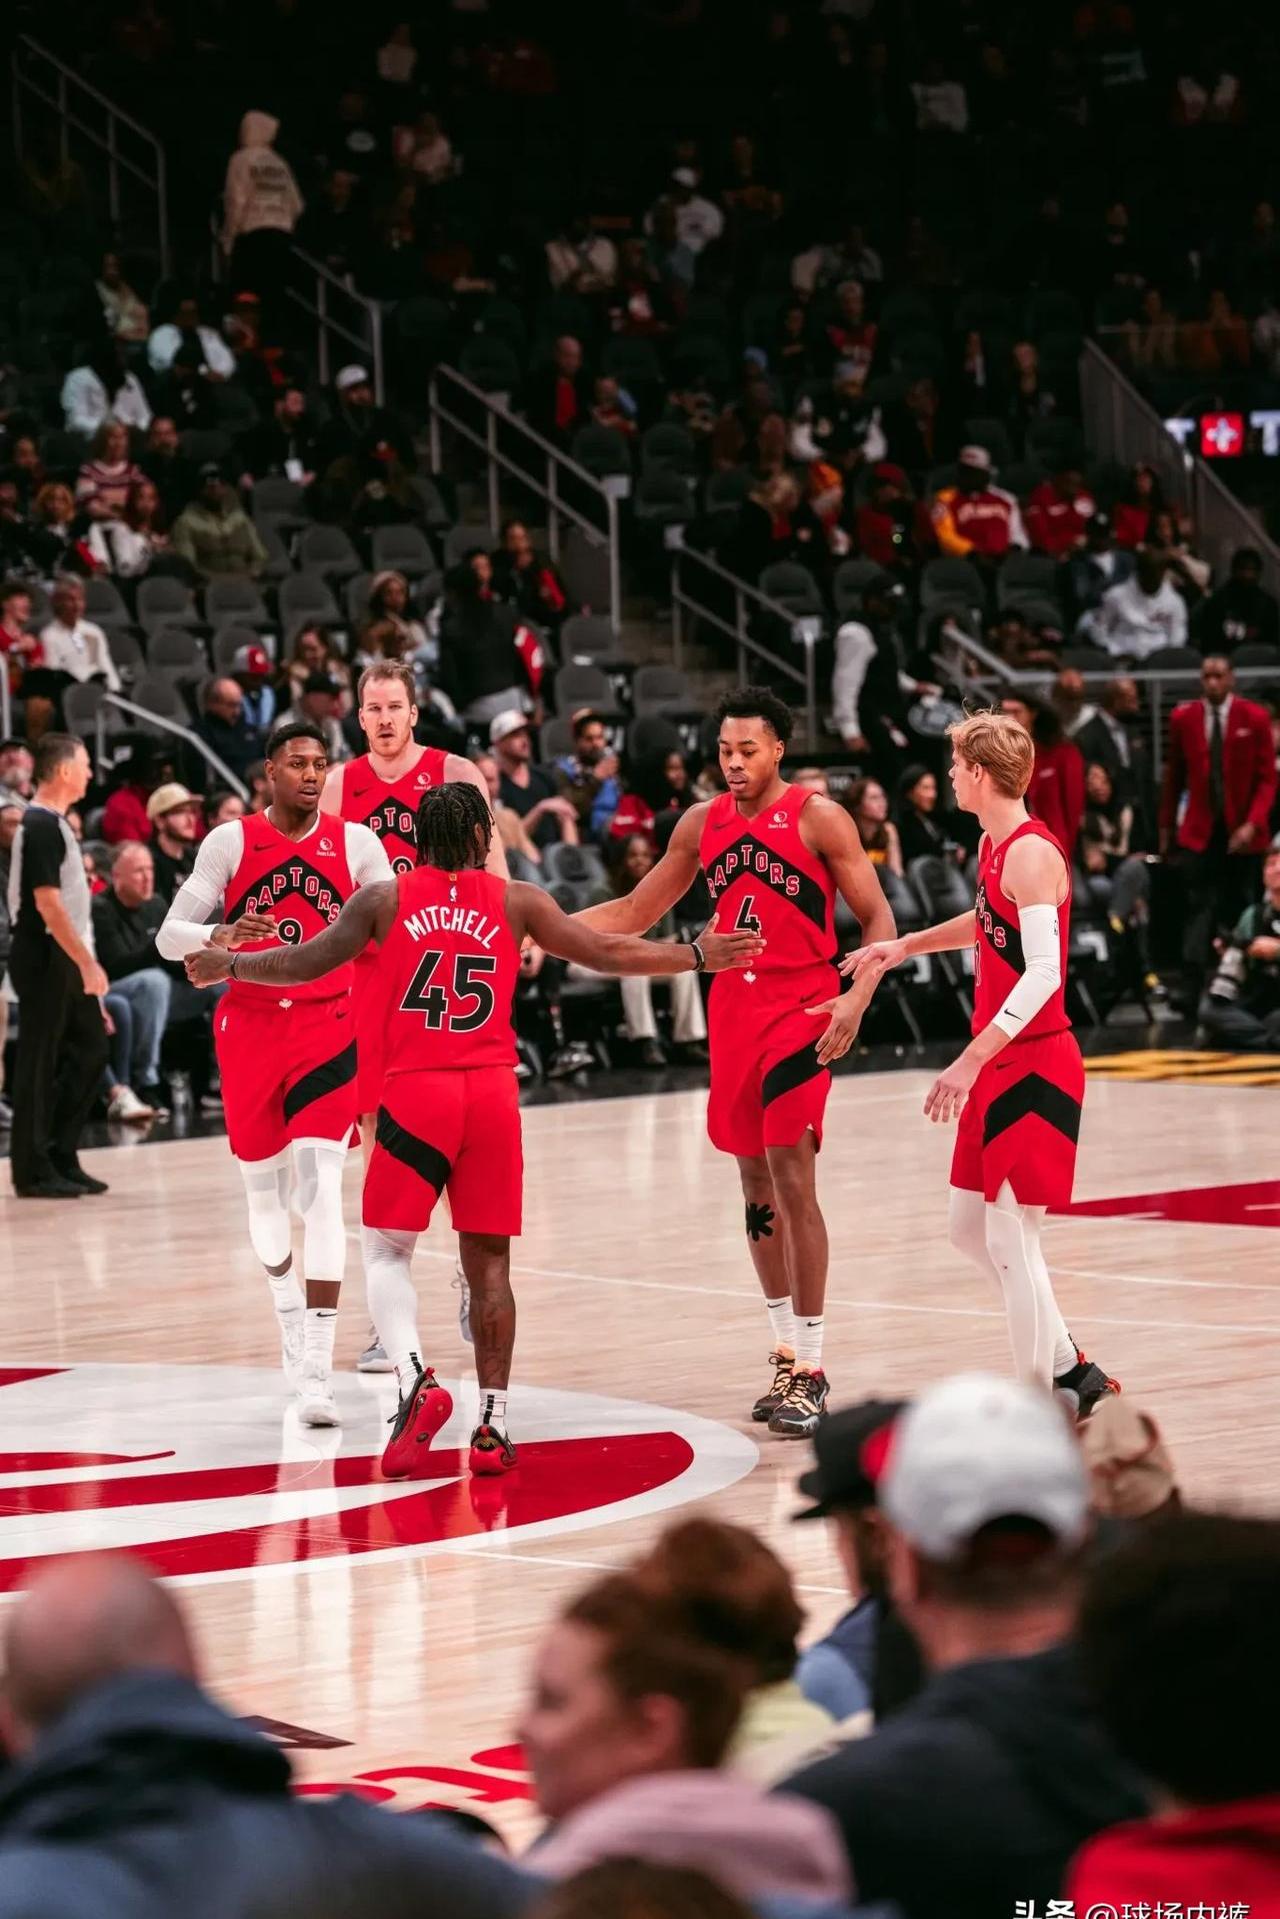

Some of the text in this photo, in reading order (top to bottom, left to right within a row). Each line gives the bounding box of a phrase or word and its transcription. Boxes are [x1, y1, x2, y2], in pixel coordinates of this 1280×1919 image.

[246, 866, 341, 924] RAPTORS
[707, 844, 800, 896] RAPTORS
[403, 905, 500, 949] MITCHELL
[733, 895, 762, 938] 4
[399, 949, 497, 1033] 45
